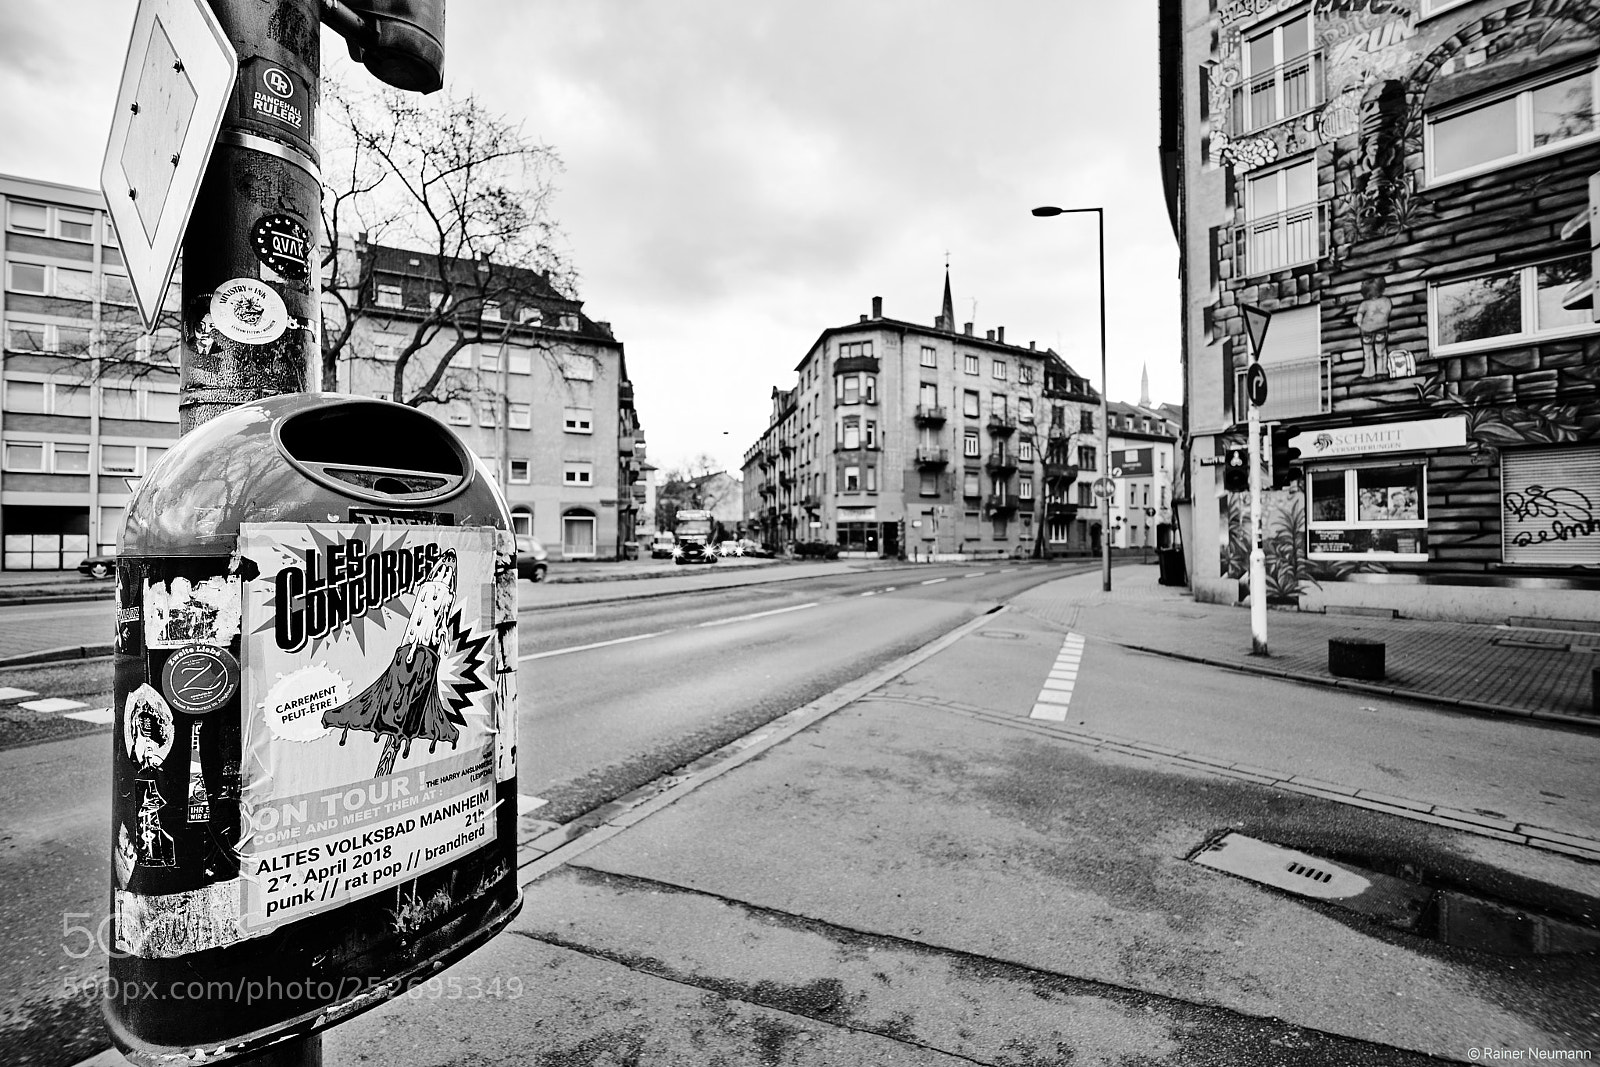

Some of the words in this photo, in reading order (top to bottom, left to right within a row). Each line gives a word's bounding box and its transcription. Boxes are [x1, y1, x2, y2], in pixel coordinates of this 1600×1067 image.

[253, 99, 302, 127] RULERZ
[254, 91, 302, 118] DANCEHALL
[1336, 430, 1404, 445] SCHMITT
[306, 539, 368, 594] LES
[275, 543, 438, 654] CONCORDES
[275, 685, 336, 714] CARREMENT
[281, 698, 332, 725] PEUT-ÊTRE
[426, 778, 440, 788] THE
[440, 772, 460, 784] HARRY
[190, 806, 204, 814] IHR
[252, 799, 307, 832] ON
[321, 776, 410, 817] TOUR
[252, 826, 301, 846] COME
[305, 818, 338, 835] AND
[342, 806, 380, 826] MEET
[384, 795, 419, 813] THEM
[422, 789, 437, 802] AT
[255, 847, 320, 876] ALTES
[326, 819, 416, 857] VOLKSBAD
[420, 789, 489, 828] MANNHEIM
[266, 887, 315, 917] punk
[345, 872, 368, 891] rat
[373, 861, 402, 885] pop
[425, 822, 485, 861] brandherd
[303, 858, 347, 884] April
[352, 844, 392, 870] 2018
